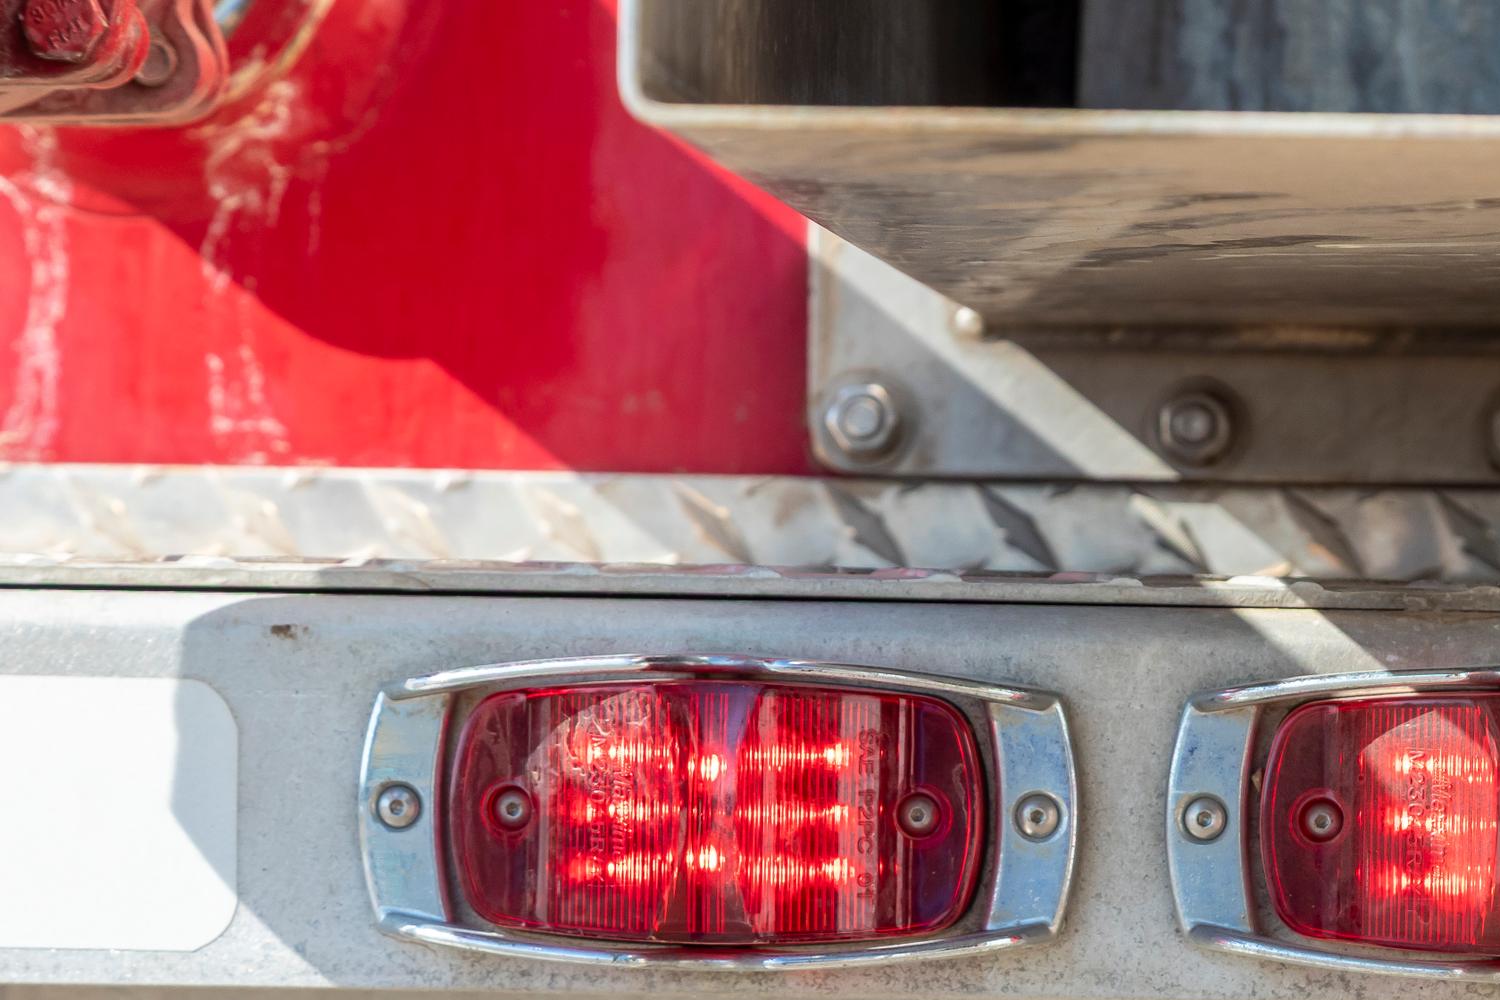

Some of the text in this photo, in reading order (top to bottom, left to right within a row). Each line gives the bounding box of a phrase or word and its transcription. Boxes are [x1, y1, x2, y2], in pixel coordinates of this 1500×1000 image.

[857, 728, 876, 900] SAE P2PC 01
